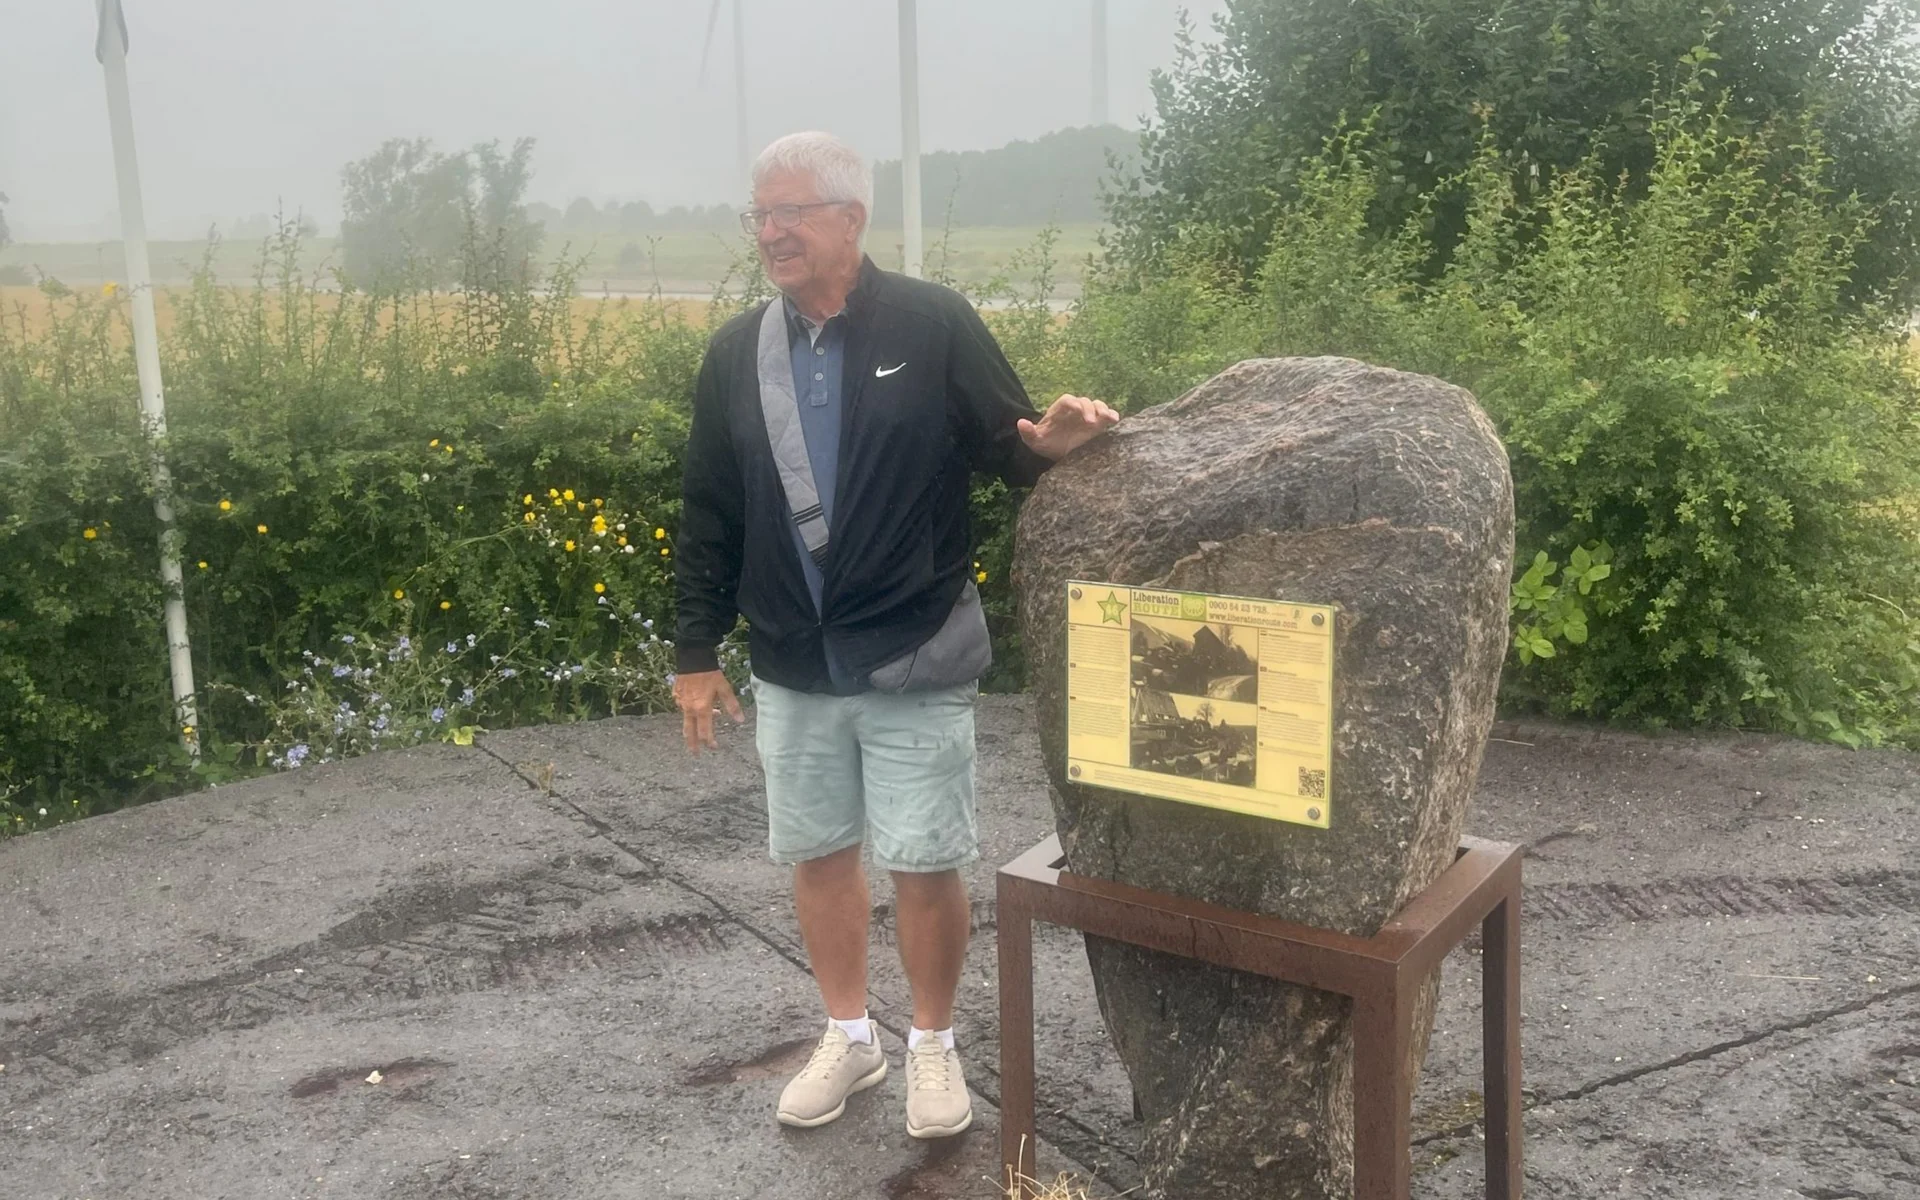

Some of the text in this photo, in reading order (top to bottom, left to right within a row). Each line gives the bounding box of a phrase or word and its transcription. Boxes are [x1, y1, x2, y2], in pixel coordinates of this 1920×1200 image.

[1133, 592, 1179, 605] Liberation
[1133, 602, 1179, 617] ROUTE
[1209, 601, 1227, 610] 0900
